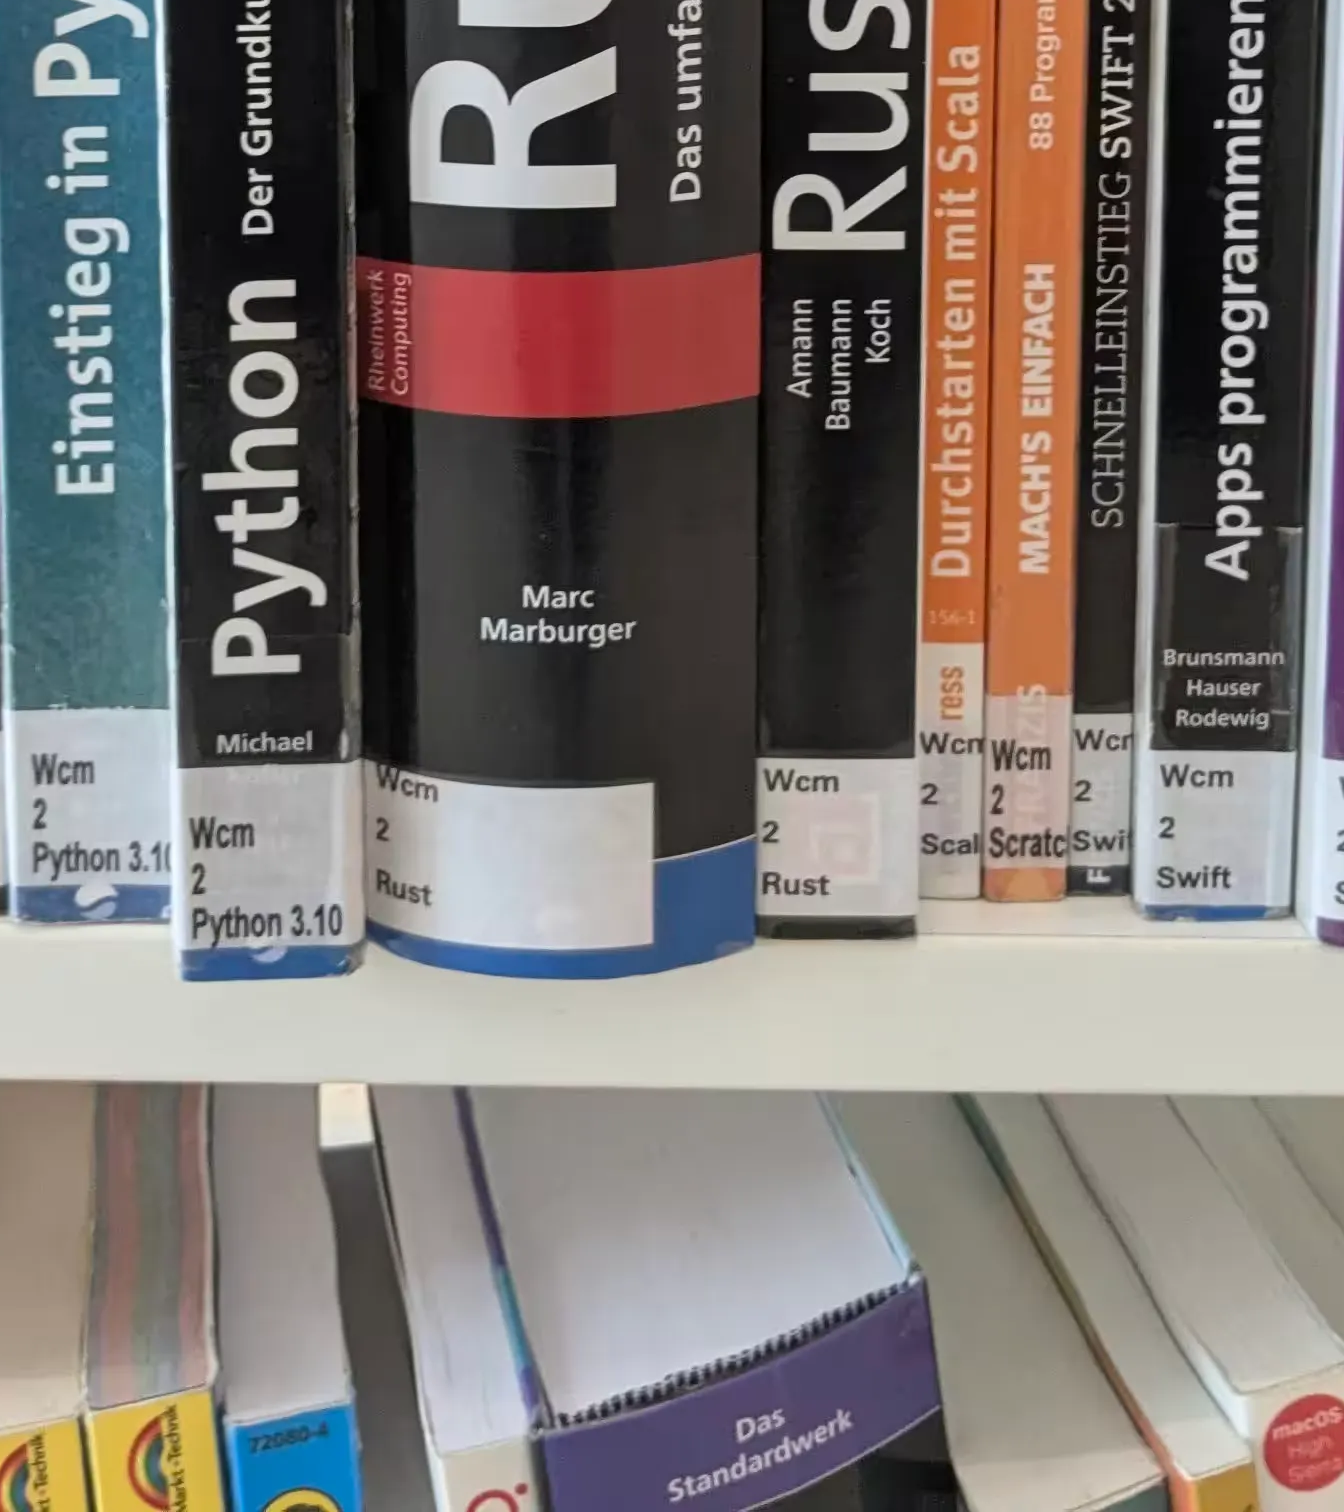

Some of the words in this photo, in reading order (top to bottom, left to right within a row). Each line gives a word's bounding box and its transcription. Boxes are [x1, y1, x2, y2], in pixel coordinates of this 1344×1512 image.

[936, 44, 983, 177] Scala
[1029, 108, 1053, 152] 88
[1098, 23, 1138, 160] SWIFT
[45, 126, 110, 190] in
[241, 161, 274, 237] Der
[668, 122, 702, 203] Das
[934, 186, 976, 258] mit
[48, 214, 130, 496] Einstieg
[786, 298, 813, 399] Amann
[825, 298, 853, 432] Baumann
[864, 298, 891, 364] Koch
[1020, 263, 1056, 417] EINFACH
[1090, 171, 1133, 530] SCHNELLEINSTIEG
[930, 268, 975, 580] Durchstarten
[201, 278, 327, 676] Python
[1017, 427, 1052, 575] MACH'S
[1204, 435, 1254, 581] Apps
[479, 614, 637, 648] Marburger
[521, 585, 595, 610] Marc
[1162, 647, 1285, 667] Brunsmann
[216, 730, 313, 753] Michael
[191, 909, 283, 947] Python
[290, 905, 343, 939] 3.10
[666, 1407, 854, 1506] Standardwerk
[735, 1407, 786, 1445] Das
